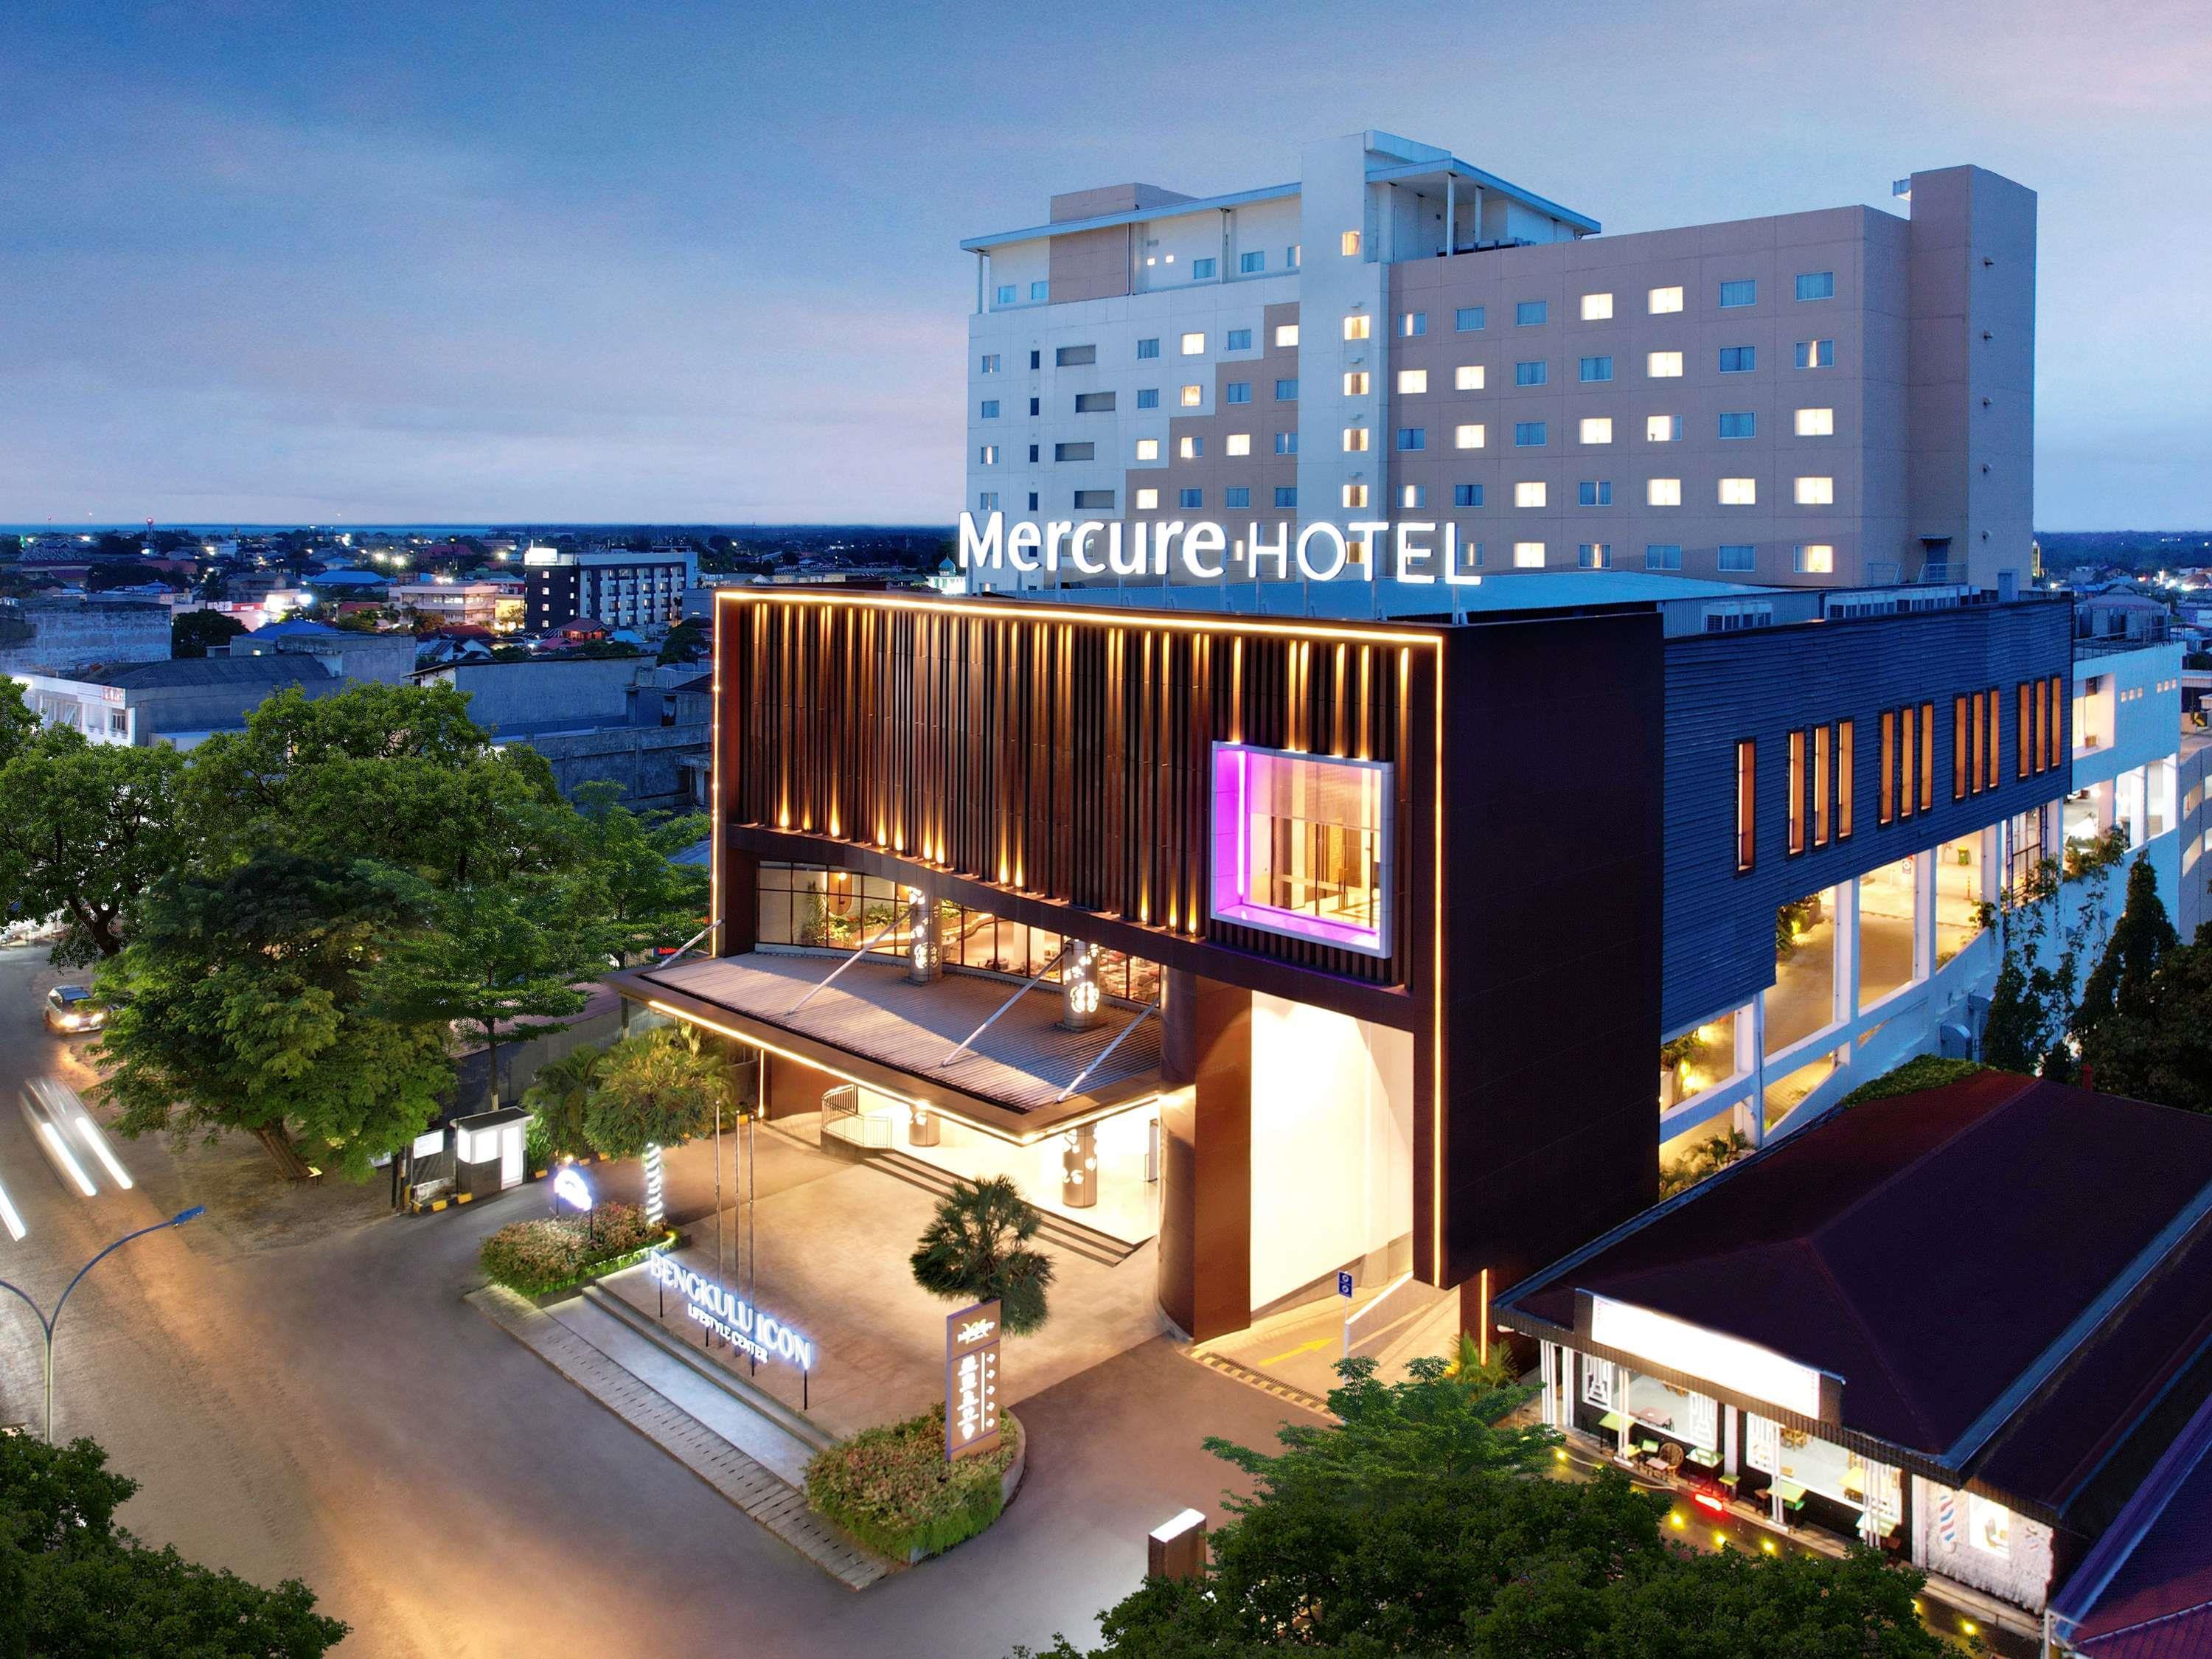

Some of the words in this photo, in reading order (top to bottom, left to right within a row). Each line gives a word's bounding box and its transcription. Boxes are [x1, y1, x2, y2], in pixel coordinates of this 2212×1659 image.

[959, 512, 1226, 577] Mercure
[1249, 521, 1481, 585] HOTEL
[650, 1251, 753, 1332] BENGKULU
[757, 1314, 811, 1369] ICON
[688, 1303, 731, 1340] LIFESTYLE
[731, 1331, 768, 1363] CENTER
